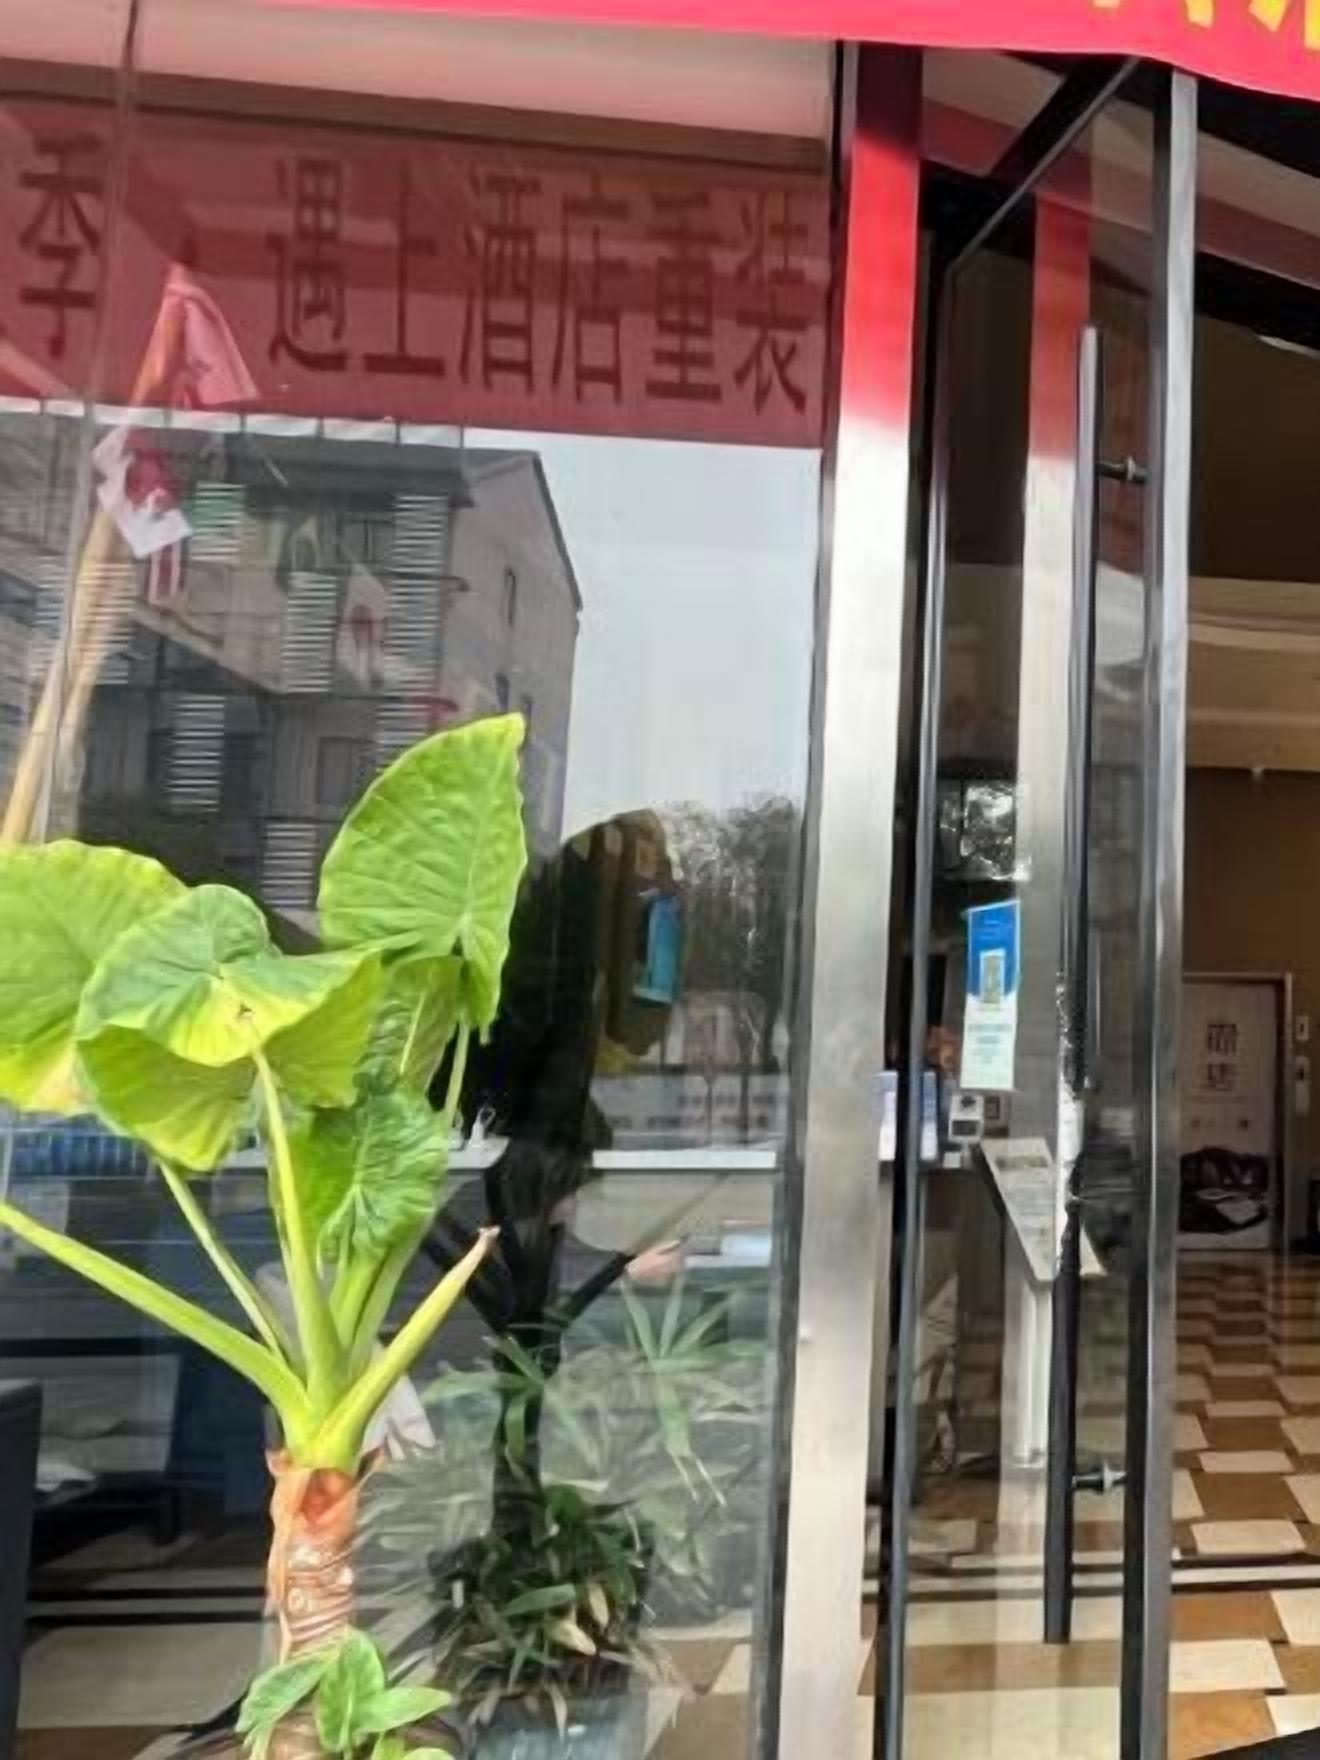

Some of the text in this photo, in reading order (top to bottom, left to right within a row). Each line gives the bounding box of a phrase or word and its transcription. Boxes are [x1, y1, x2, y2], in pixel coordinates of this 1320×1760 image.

[266, 158, 808, 416] 遇上酒店重装
